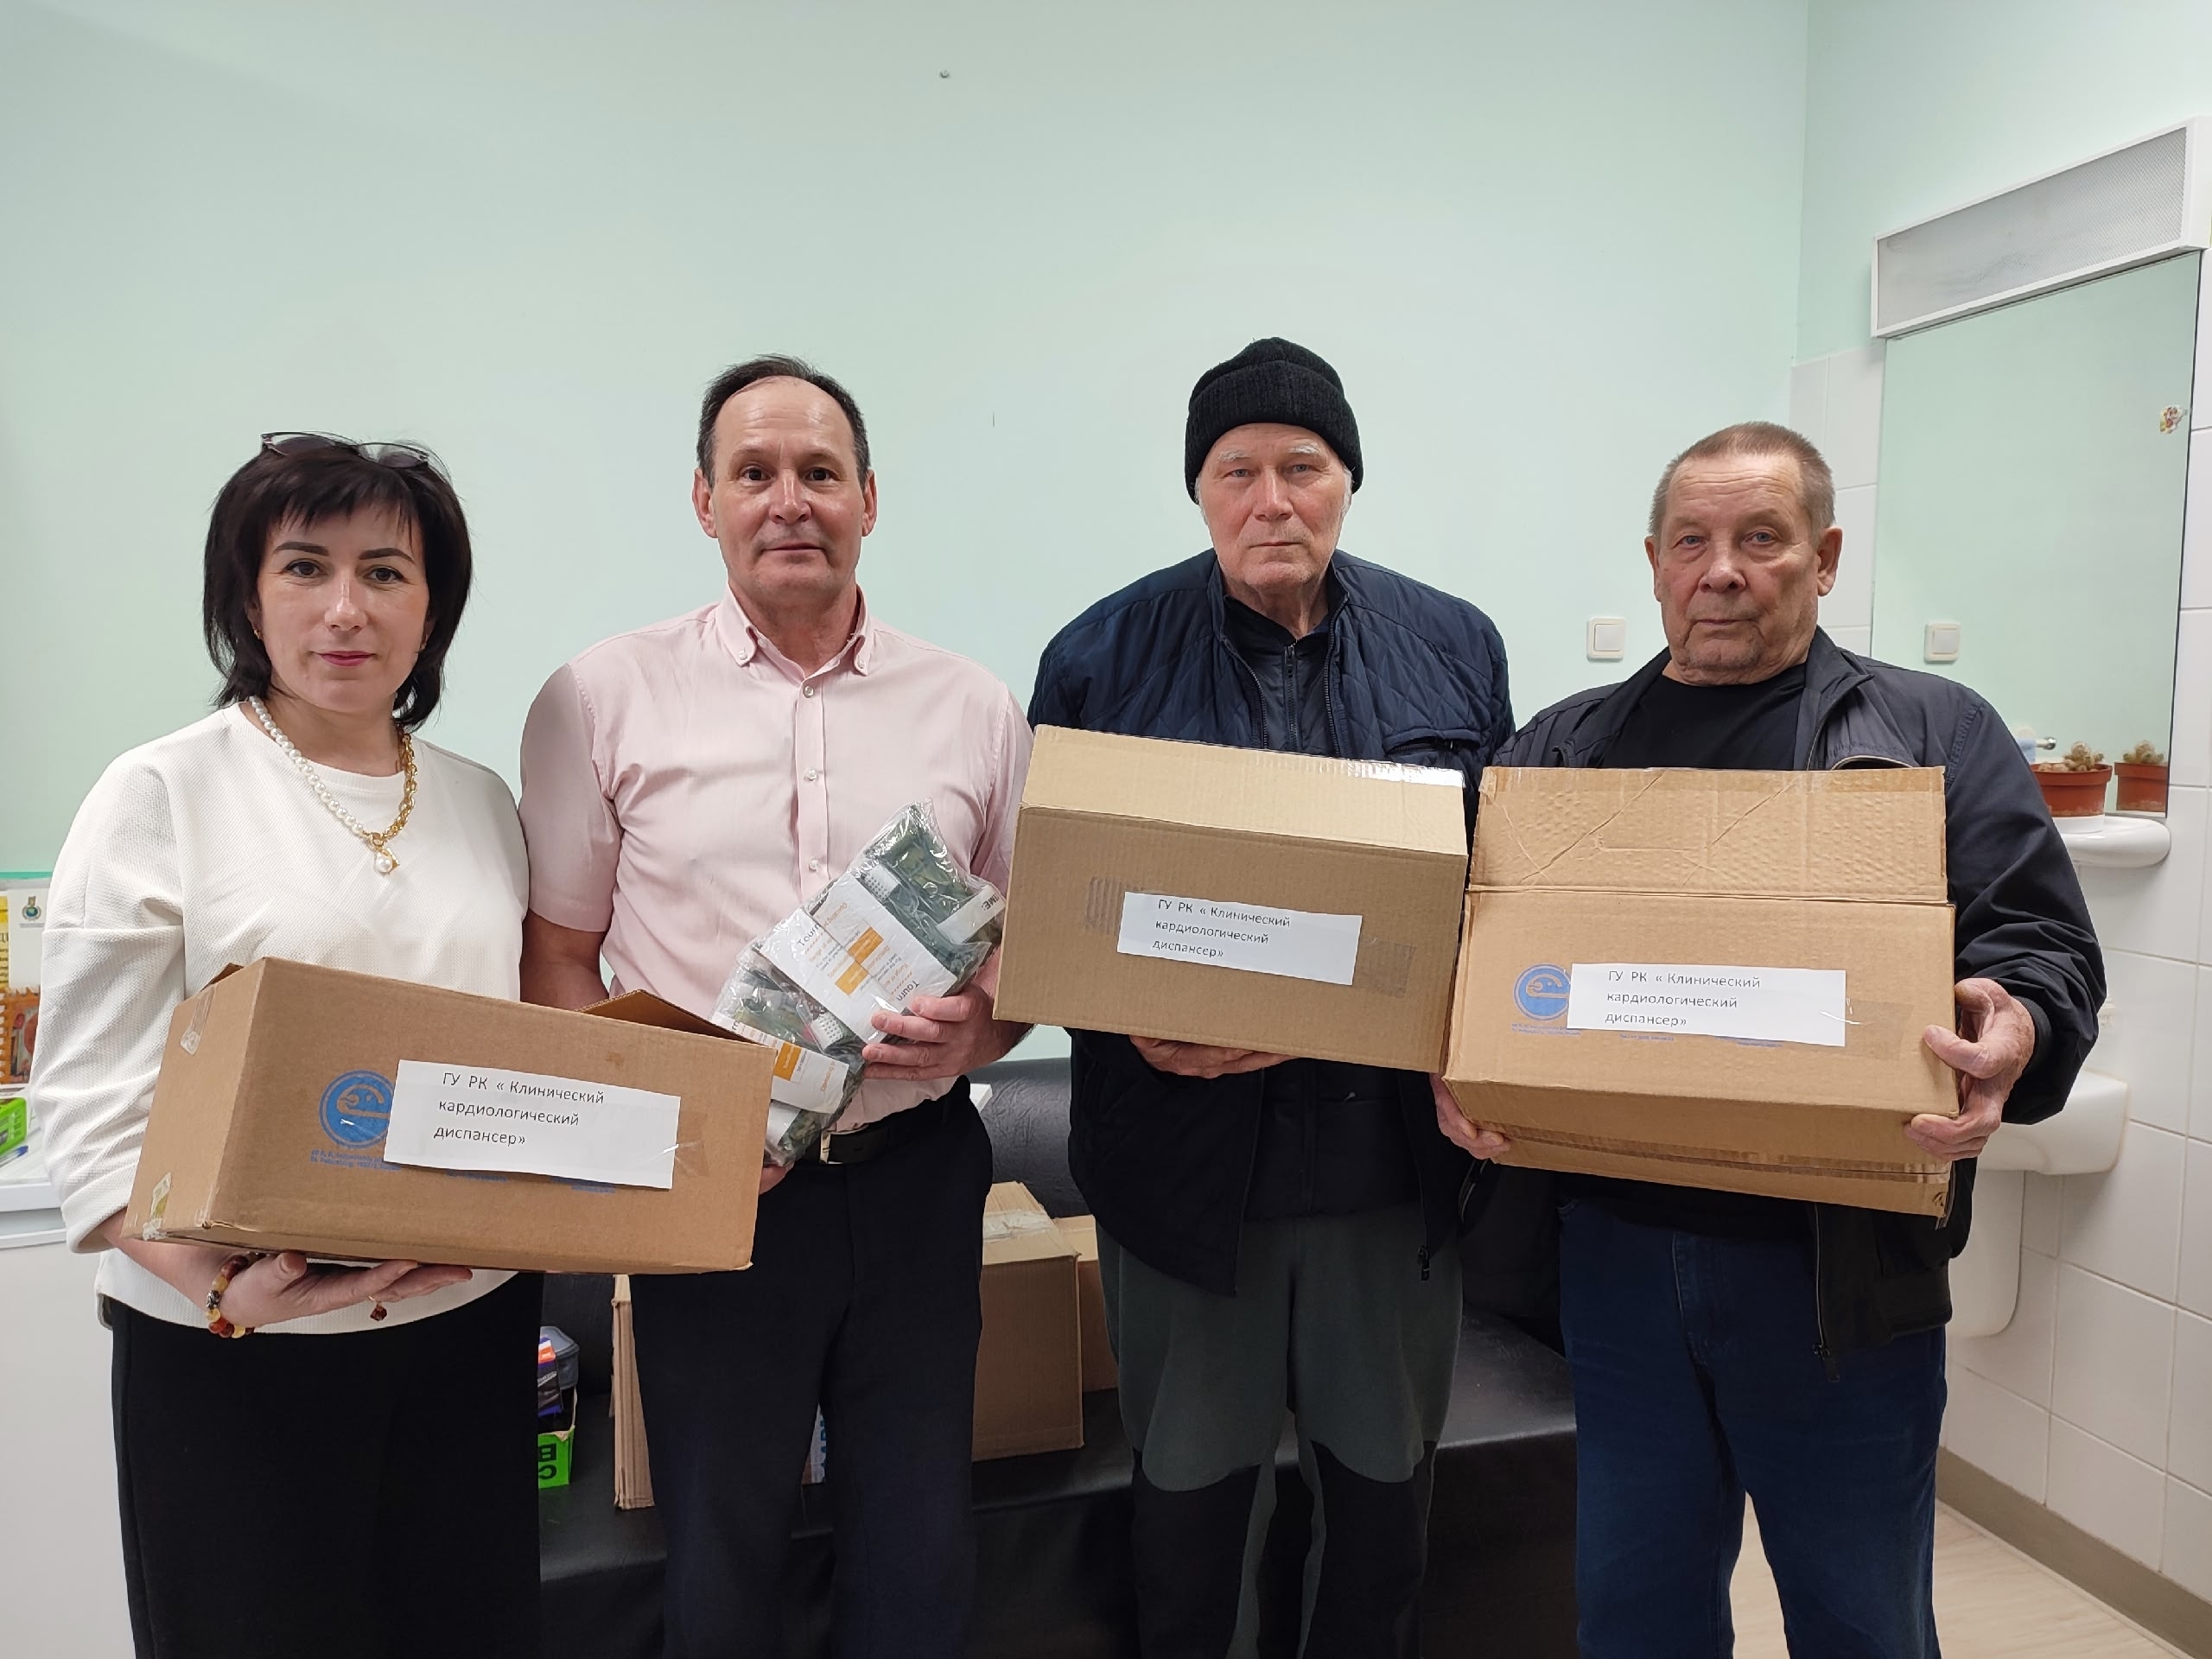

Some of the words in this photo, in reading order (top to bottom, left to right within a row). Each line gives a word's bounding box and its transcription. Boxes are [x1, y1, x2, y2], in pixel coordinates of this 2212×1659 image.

[1159, 899, 1173, 910] ГУ
[1179, 902, 1193, 913] РК
[1211, 906, 1290, 927] Клинический
[1155, 919, 1268, 944] кардиологический
[1152, 939, 1224, 957] диспансер»
[1609, 970, 1624, 982] ГУ
[1631, 971, 1648, 982] РК
[1668, 973, 1761, 988] Клинический
[1607, 991, 1738, 1009] кардиологический
[1605, 1012, 1687, 1028] диспансер»
[442, 1072, 461, 1086] ГУ
[469, 1075, 488, 1090] РК
[510, 1080, 605, 1104] Клинический
[439, 1099, 580, 1126] кардиологический
[434, 1126, 525, 1147] диспансер»
